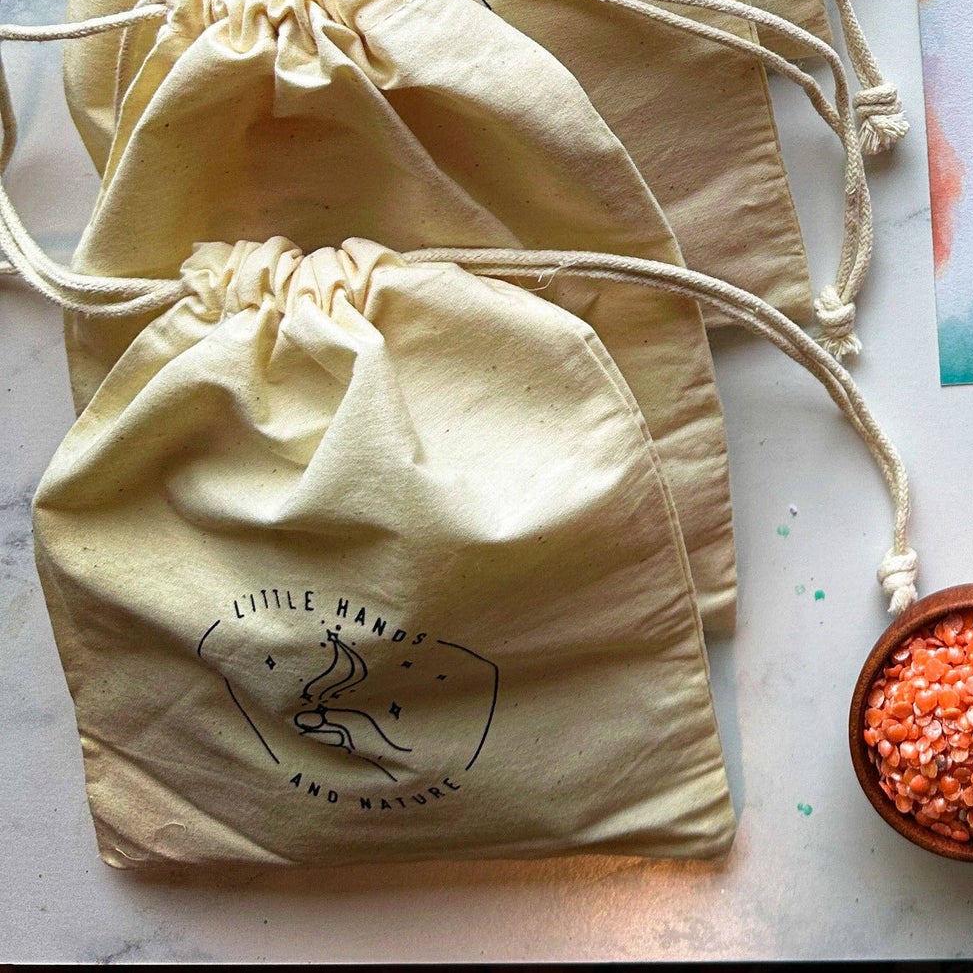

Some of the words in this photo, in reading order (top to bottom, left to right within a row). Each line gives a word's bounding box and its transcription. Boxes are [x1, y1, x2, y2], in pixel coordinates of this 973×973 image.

[233, 588, 314, 619] LITTLE
[335, 597, 426, 644] HANDS
[289, 772, 338, 803] AND
[358, 776, 461, 810] NATURE
